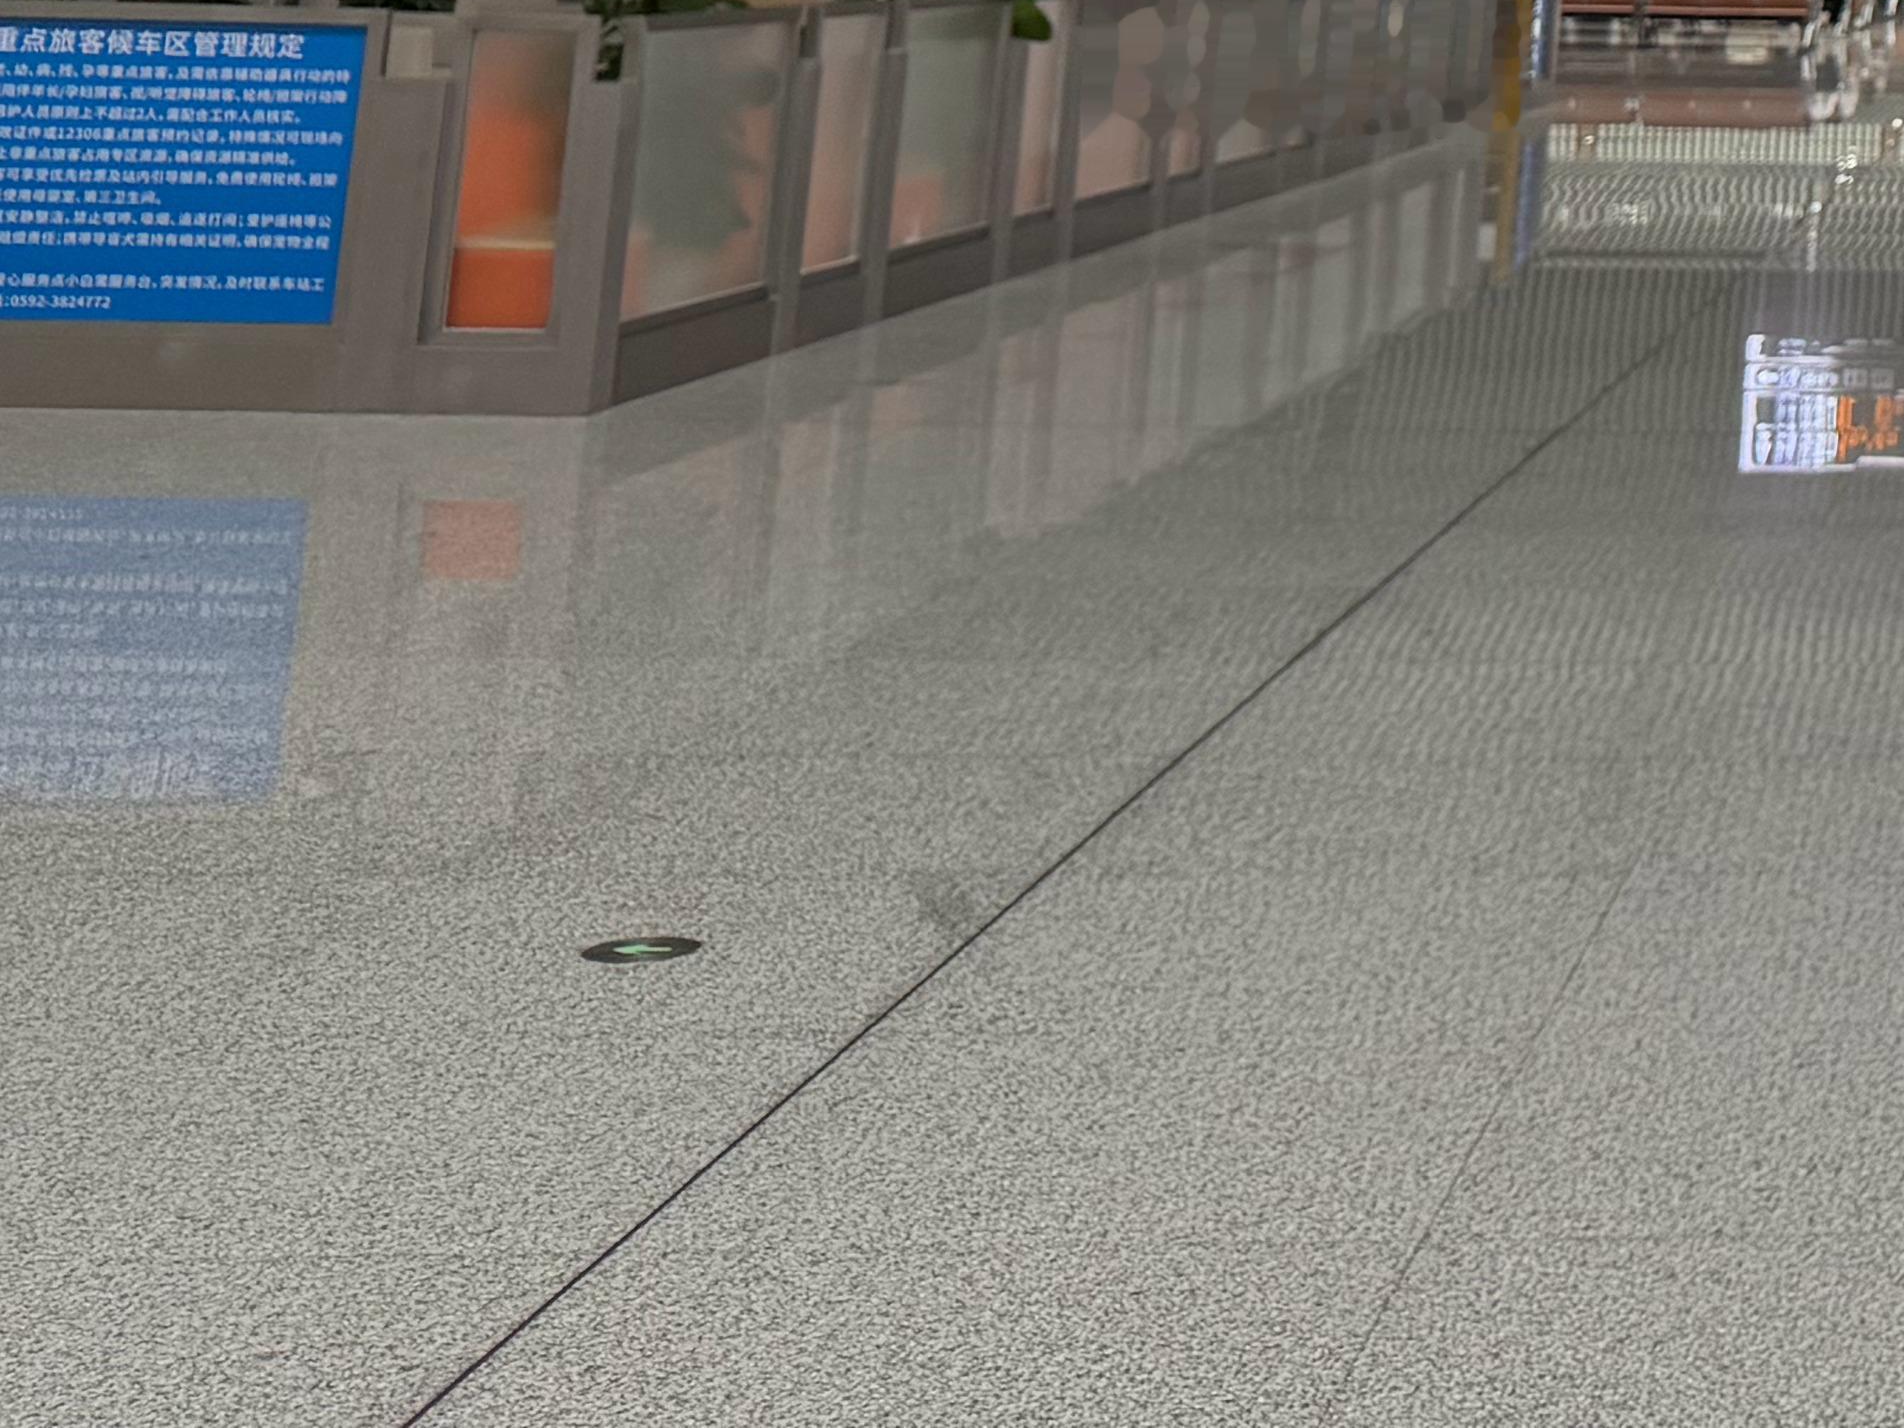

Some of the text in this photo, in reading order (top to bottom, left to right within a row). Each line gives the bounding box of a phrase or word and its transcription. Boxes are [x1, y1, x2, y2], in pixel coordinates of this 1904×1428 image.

[0, 27, 305, 60] 重点旅客候车区管理规定
